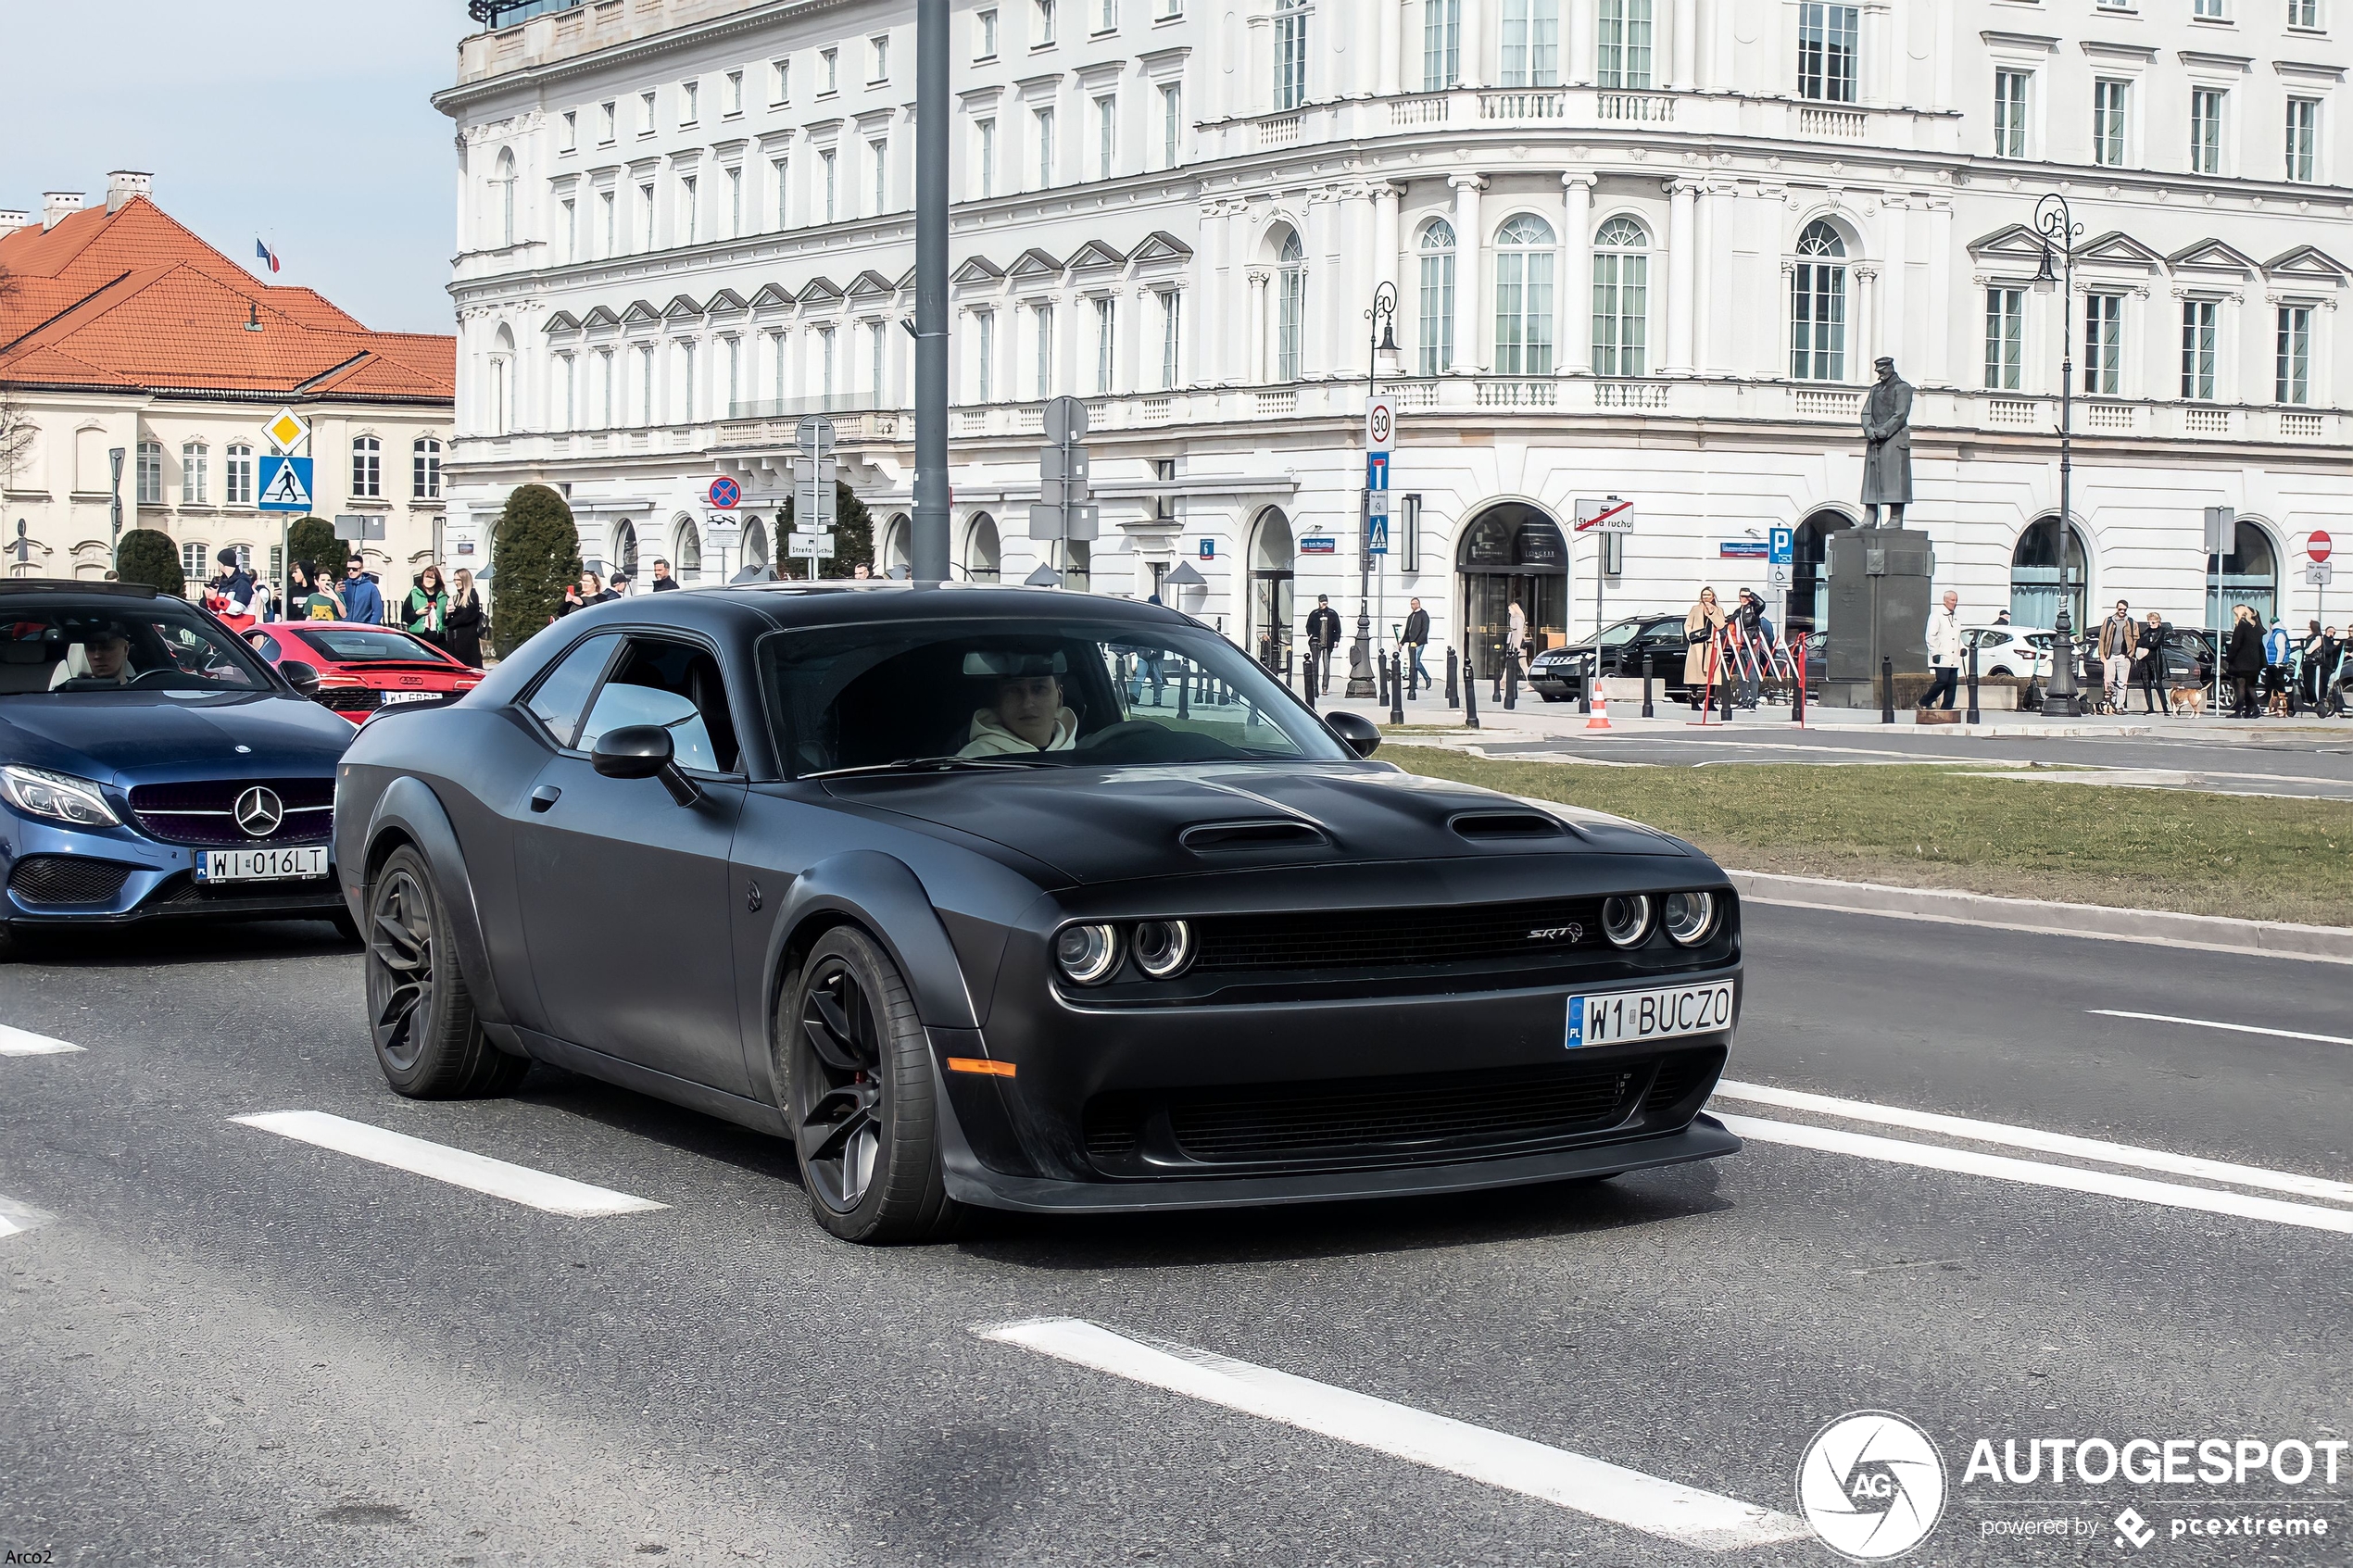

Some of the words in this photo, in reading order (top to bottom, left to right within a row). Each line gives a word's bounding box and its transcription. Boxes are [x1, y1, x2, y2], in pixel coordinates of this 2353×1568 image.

[1373, 415, 1388, 433] 30
[1774, 531, 1789, 554] P
[213, 853, 238, 876] WI
[253, 849, 321, 874] 016LT
[1527, 927, 1572, 939] SRT
[1590, 998, 1623, 1041] W1
[1569, 1028, 1580, 1038] PL
